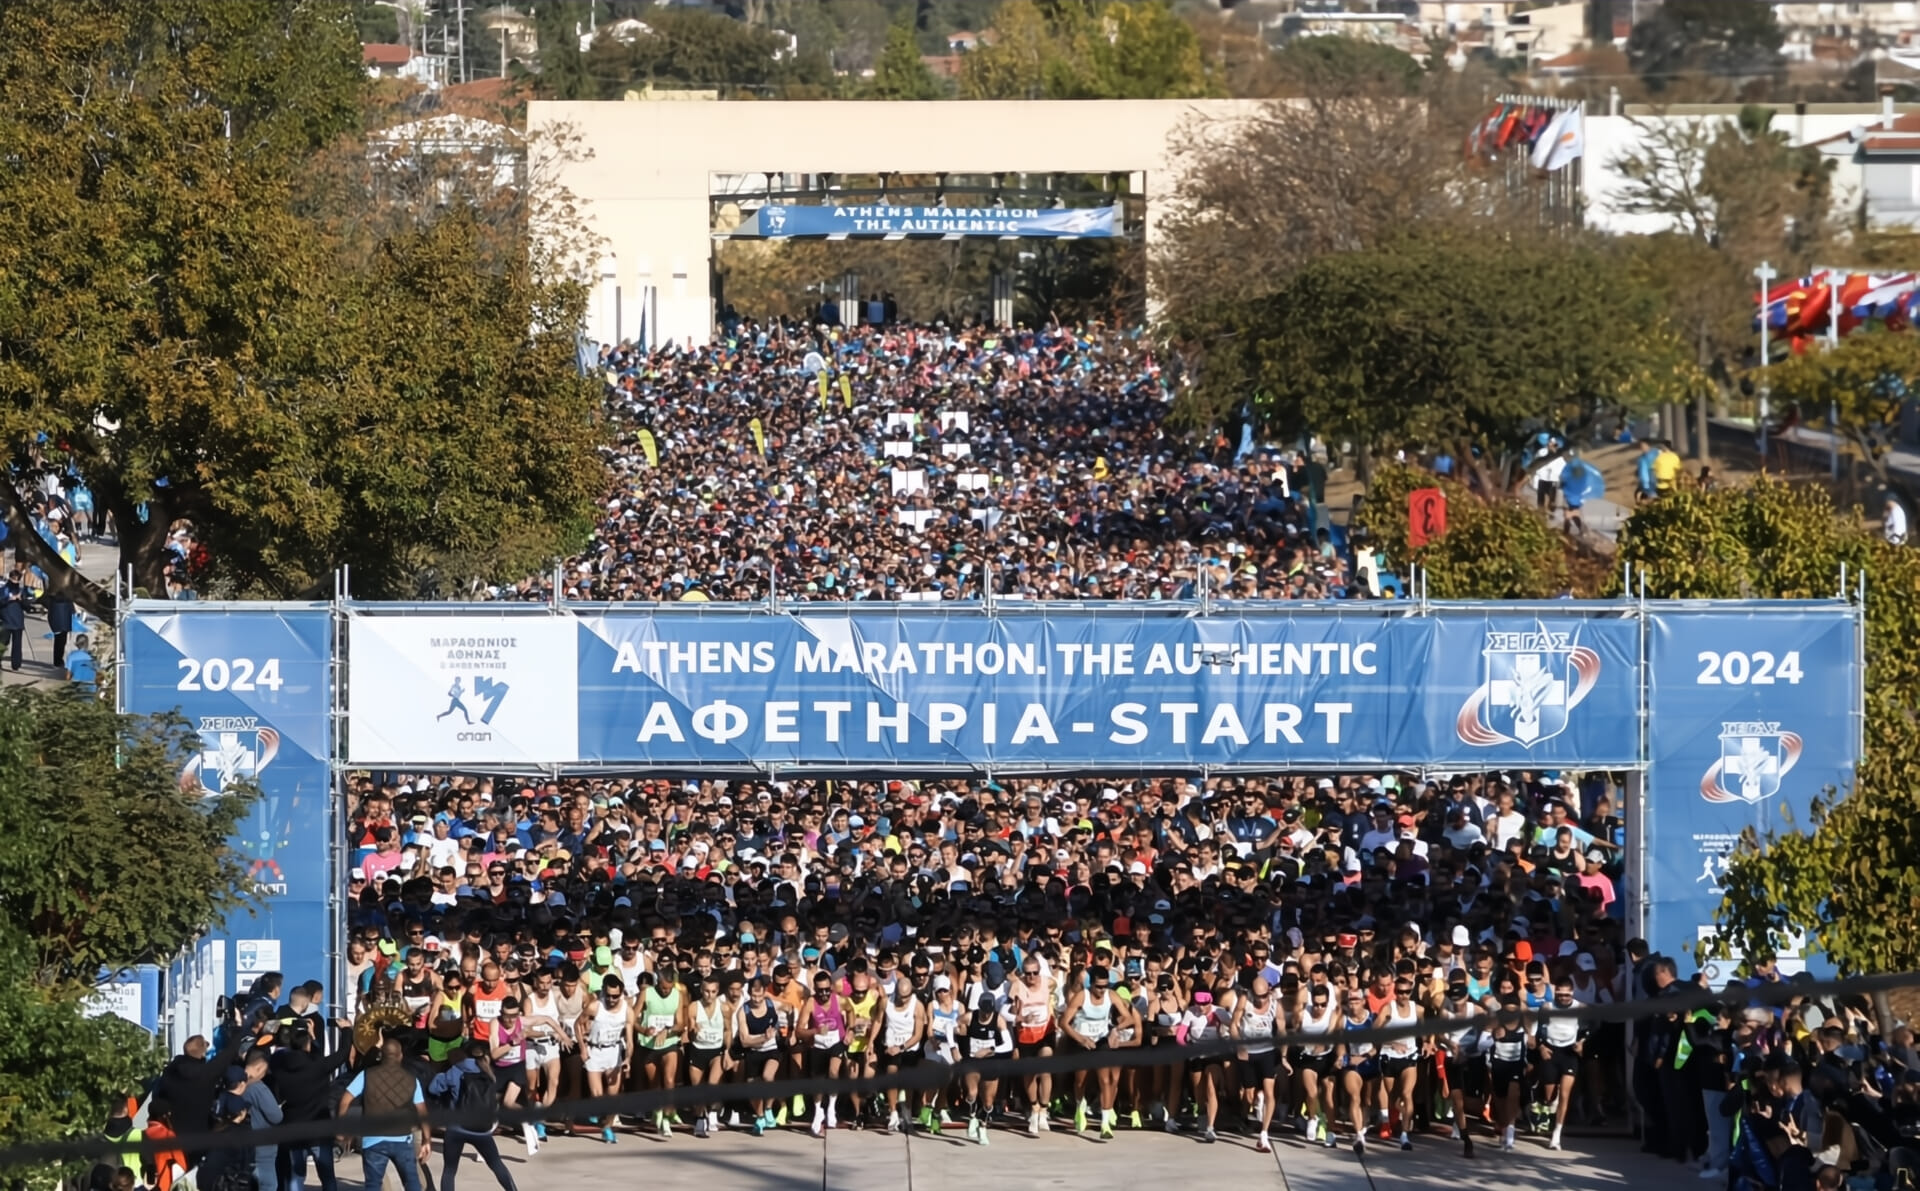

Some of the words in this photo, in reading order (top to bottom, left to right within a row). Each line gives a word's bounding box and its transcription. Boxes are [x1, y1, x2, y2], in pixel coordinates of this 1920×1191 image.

[833, 207, 913, 217] ATHENS
[924, 207, 1039, 218] MARATHON
[854, 219, 891, 230] THE
[901, 219, 1019, 232] AUTHENTIC
[430, 637, 518, 648] ΜΑΡΑΘΩΝΙΟΣ
[447, 649, 501, 660] ΑΘΗΝΑΣ
[611, 641, 776, 673] ATHENS
[794, 641, 1046, 676] MARATHON.
[1056, 642, 1134, 675] THE
[1143, 642, 1377, 676] AUTHENTIC
[176, 658, 284, 691] 2024
[1696, 651, 1804, 685] 2024
